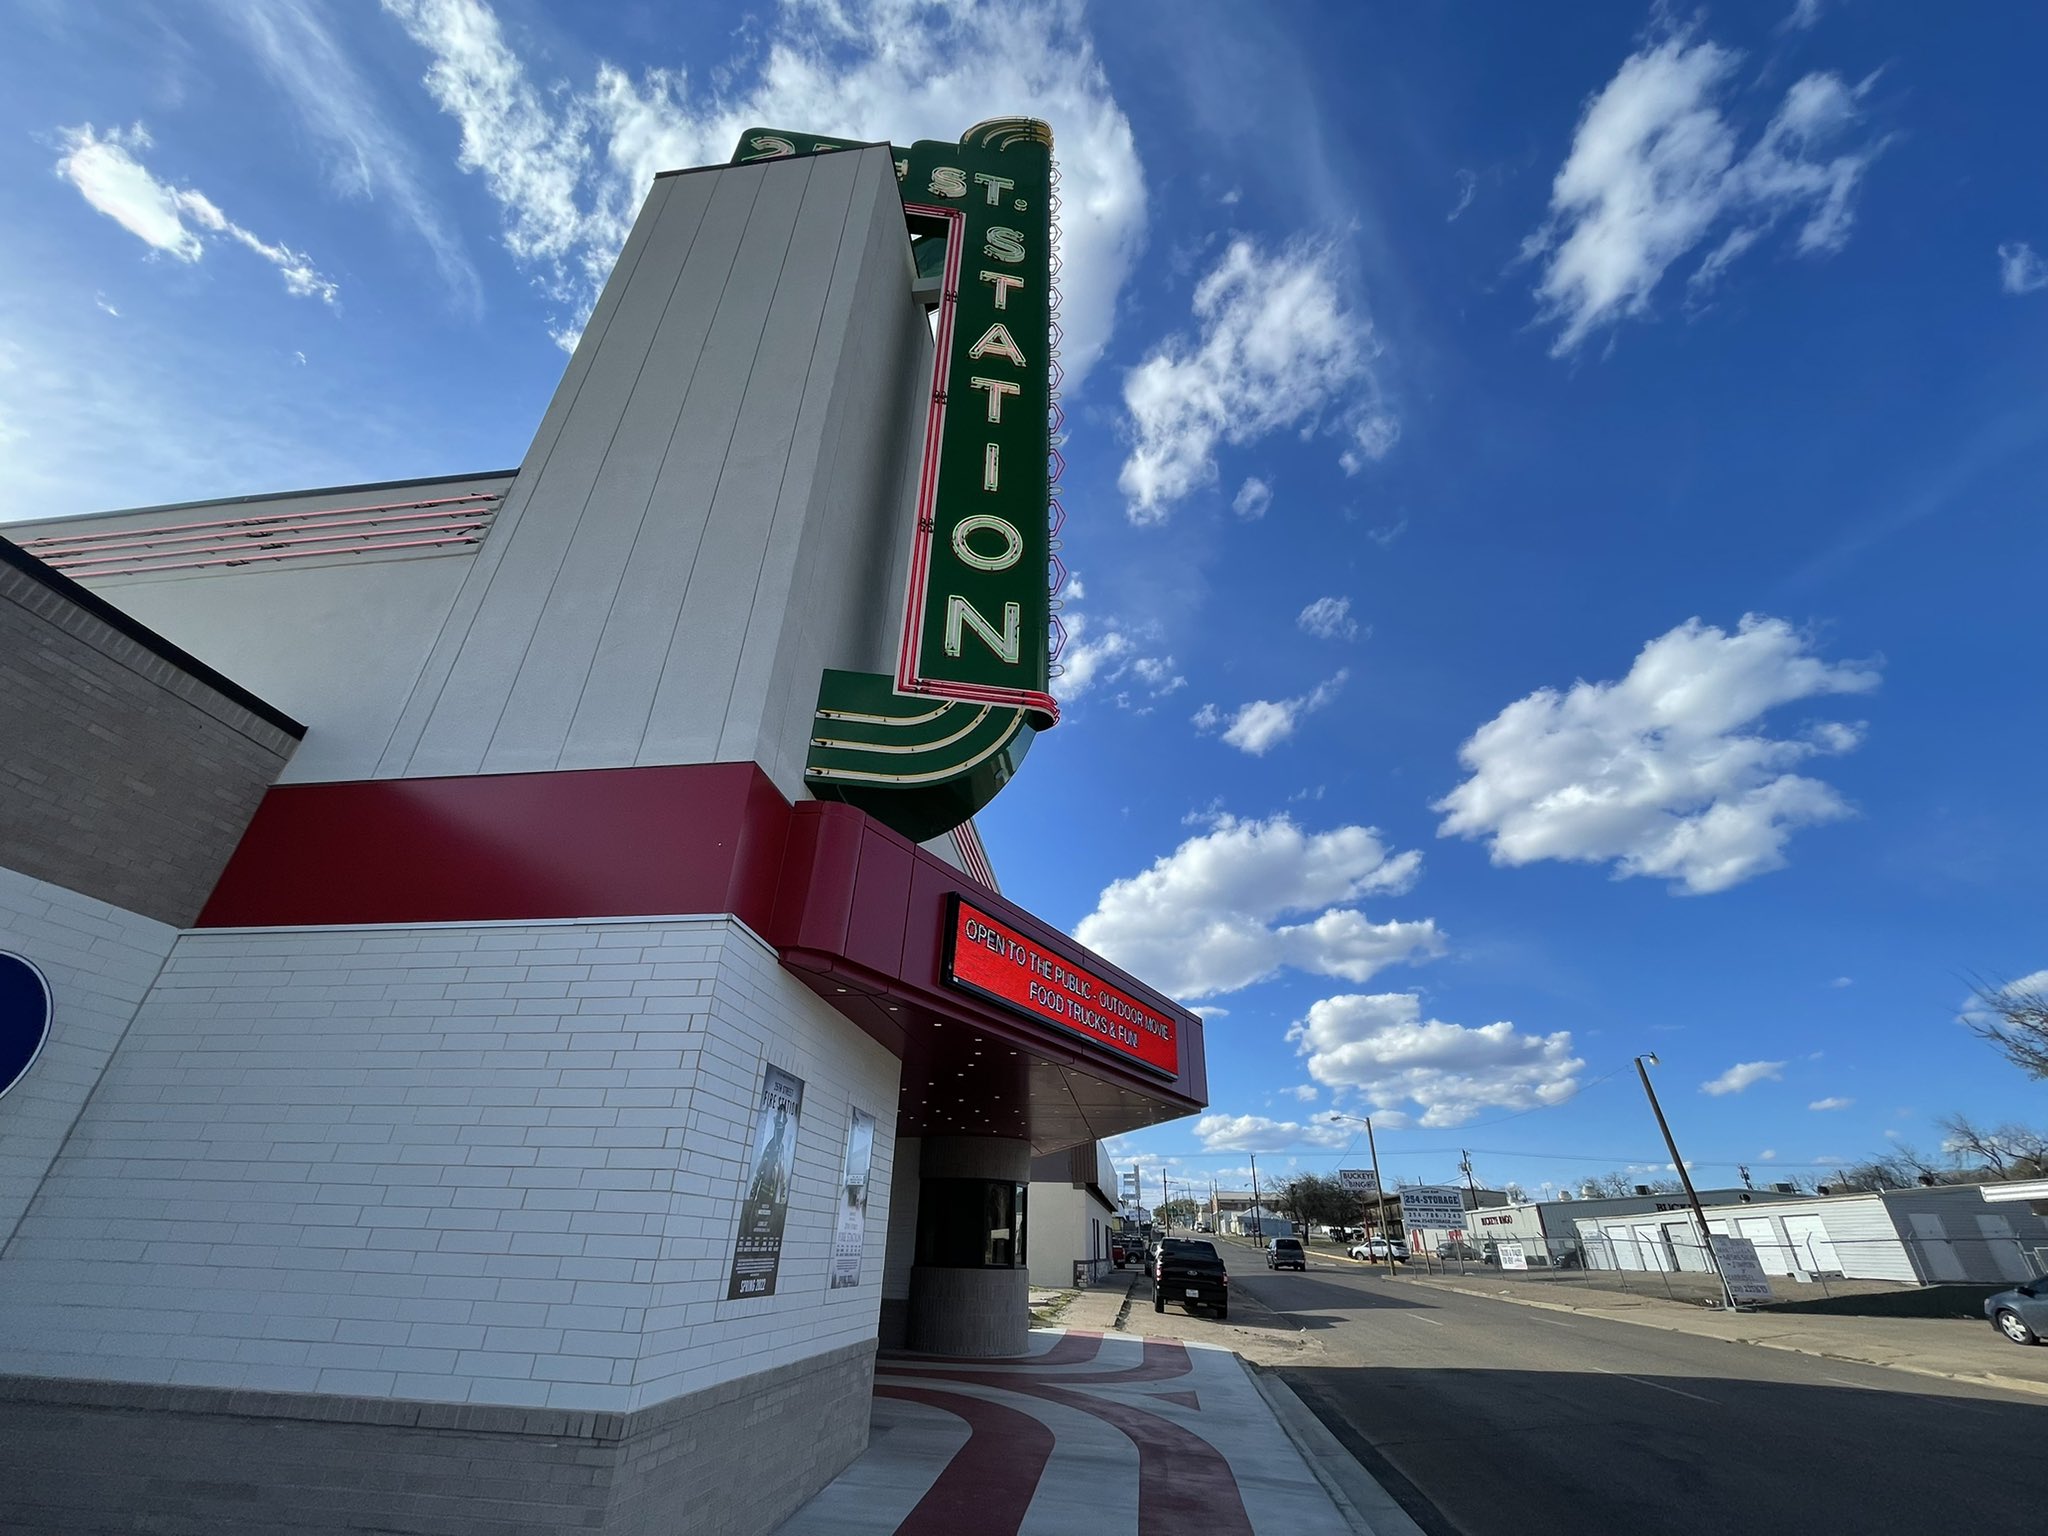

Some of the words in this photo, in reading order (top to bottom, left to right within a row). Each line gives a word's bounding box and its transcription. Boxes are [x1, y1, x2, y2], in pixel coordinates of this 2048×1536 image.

[943, 225, 1027, 664] STATION
[965, 919, 1005, 955] OPEN
[1008, 941, 1026, 965] TO
[1029, 952, 1053, 980] THE
[1055, 965, 1092, 1000] PUBLIC
[1099, 991, 1144, 1028] OUTDOOR
[1144, 1018, 1169, 1041] MOVIE
[1029, 981, 1064, 1013] FOOD
[1066, 1000, 1108, 1035] TRUCKS
[1108, 1022, 1117, 1039] &
[1118, 1025, 1139, 1048] FUN!
[1343, 1172, 1375, 1180] BUCKEYE
[1405, 1195, 1459, 1205] 254-STORAGE
